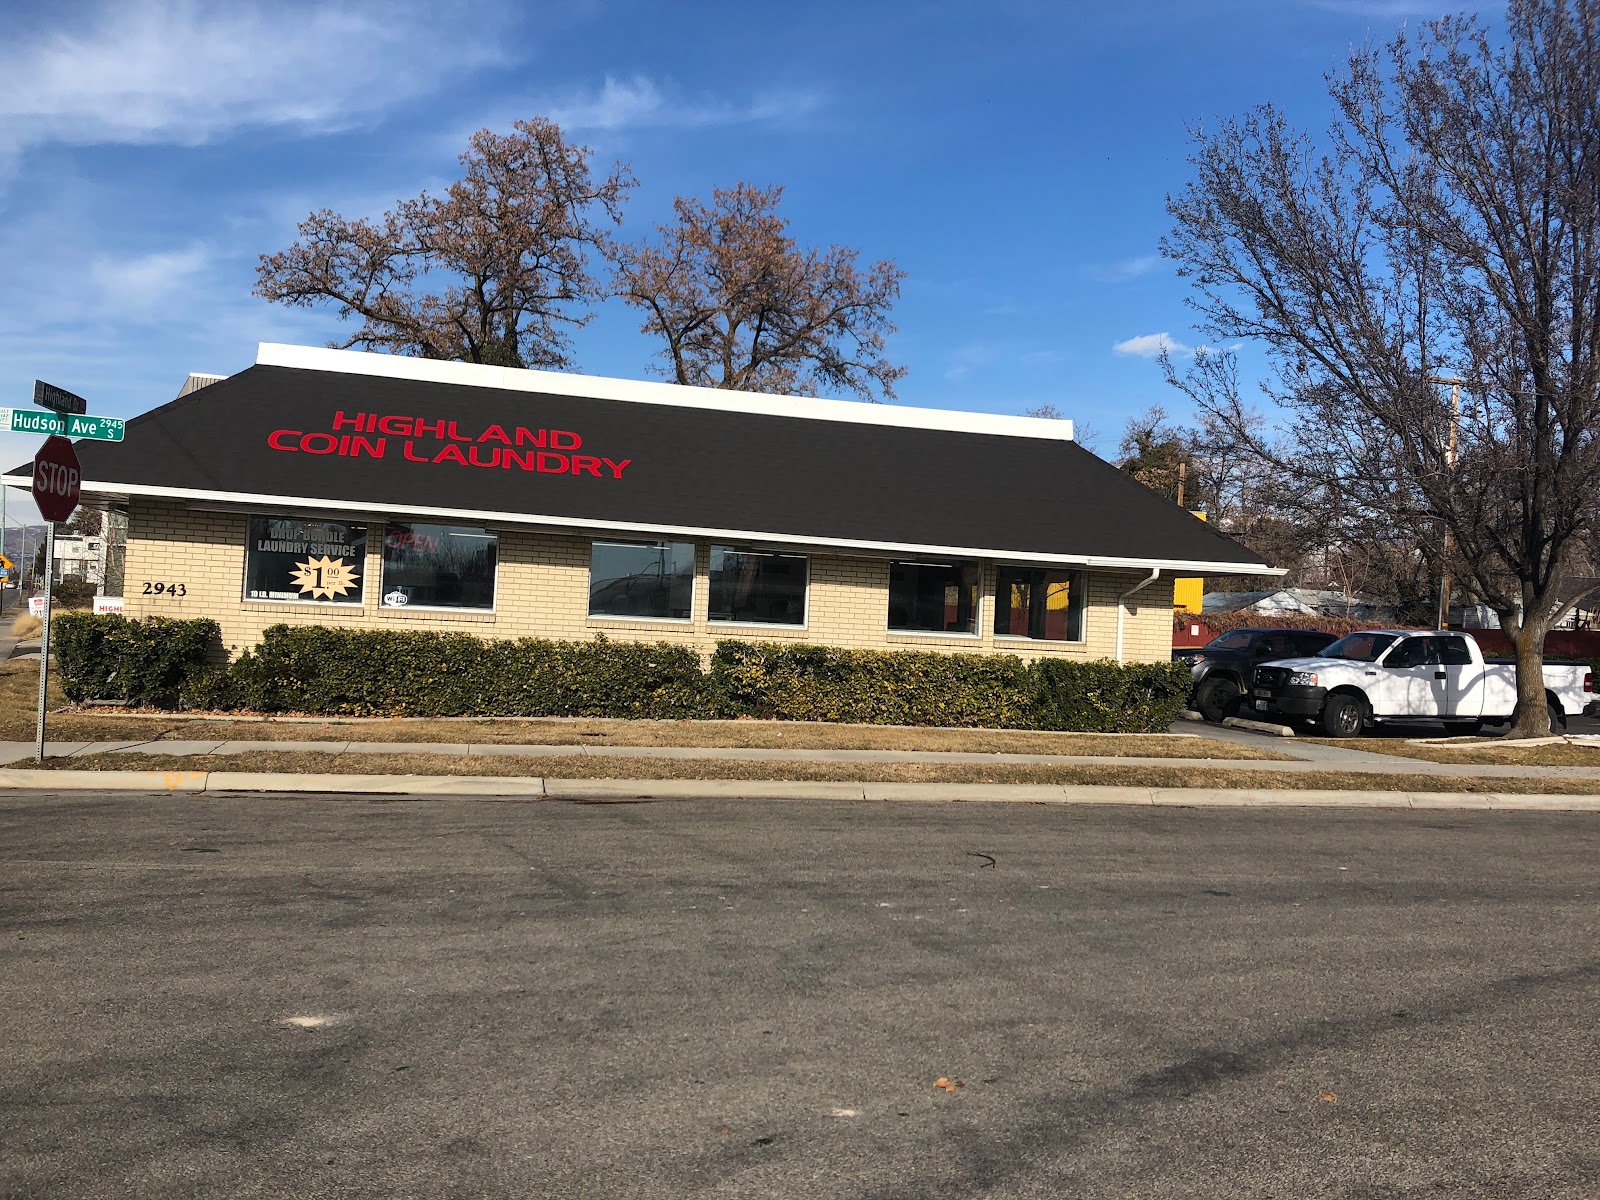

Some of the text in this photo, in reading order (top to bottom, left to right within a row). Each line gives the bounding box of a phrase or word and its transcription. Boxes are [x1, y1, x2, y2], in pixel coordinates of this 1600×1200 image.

[45, 386, 72, 409] Highland
[13, 413, 66, 433] Hudson
[71, 418, 97, 435] Ave
[100, 418, 123, 430] 2945
[332, 411, 583, 450] HIGHLAND
[107, 429, 114, 439] S
[267, 429, 632, 479] COIN LAUNDRY
[36, 460, 79, 498] STOP
[270, 528, 345, 543] DROP BUNDLE
[386, 530, 440, 555] OPEN
[257, 540, 356, 557] LAUNDRY SERVICE
[142, 582, 187, 597] 2943
[250, 590, 259, 598] 10
[269, 591, 299, 599] MINIMUM
